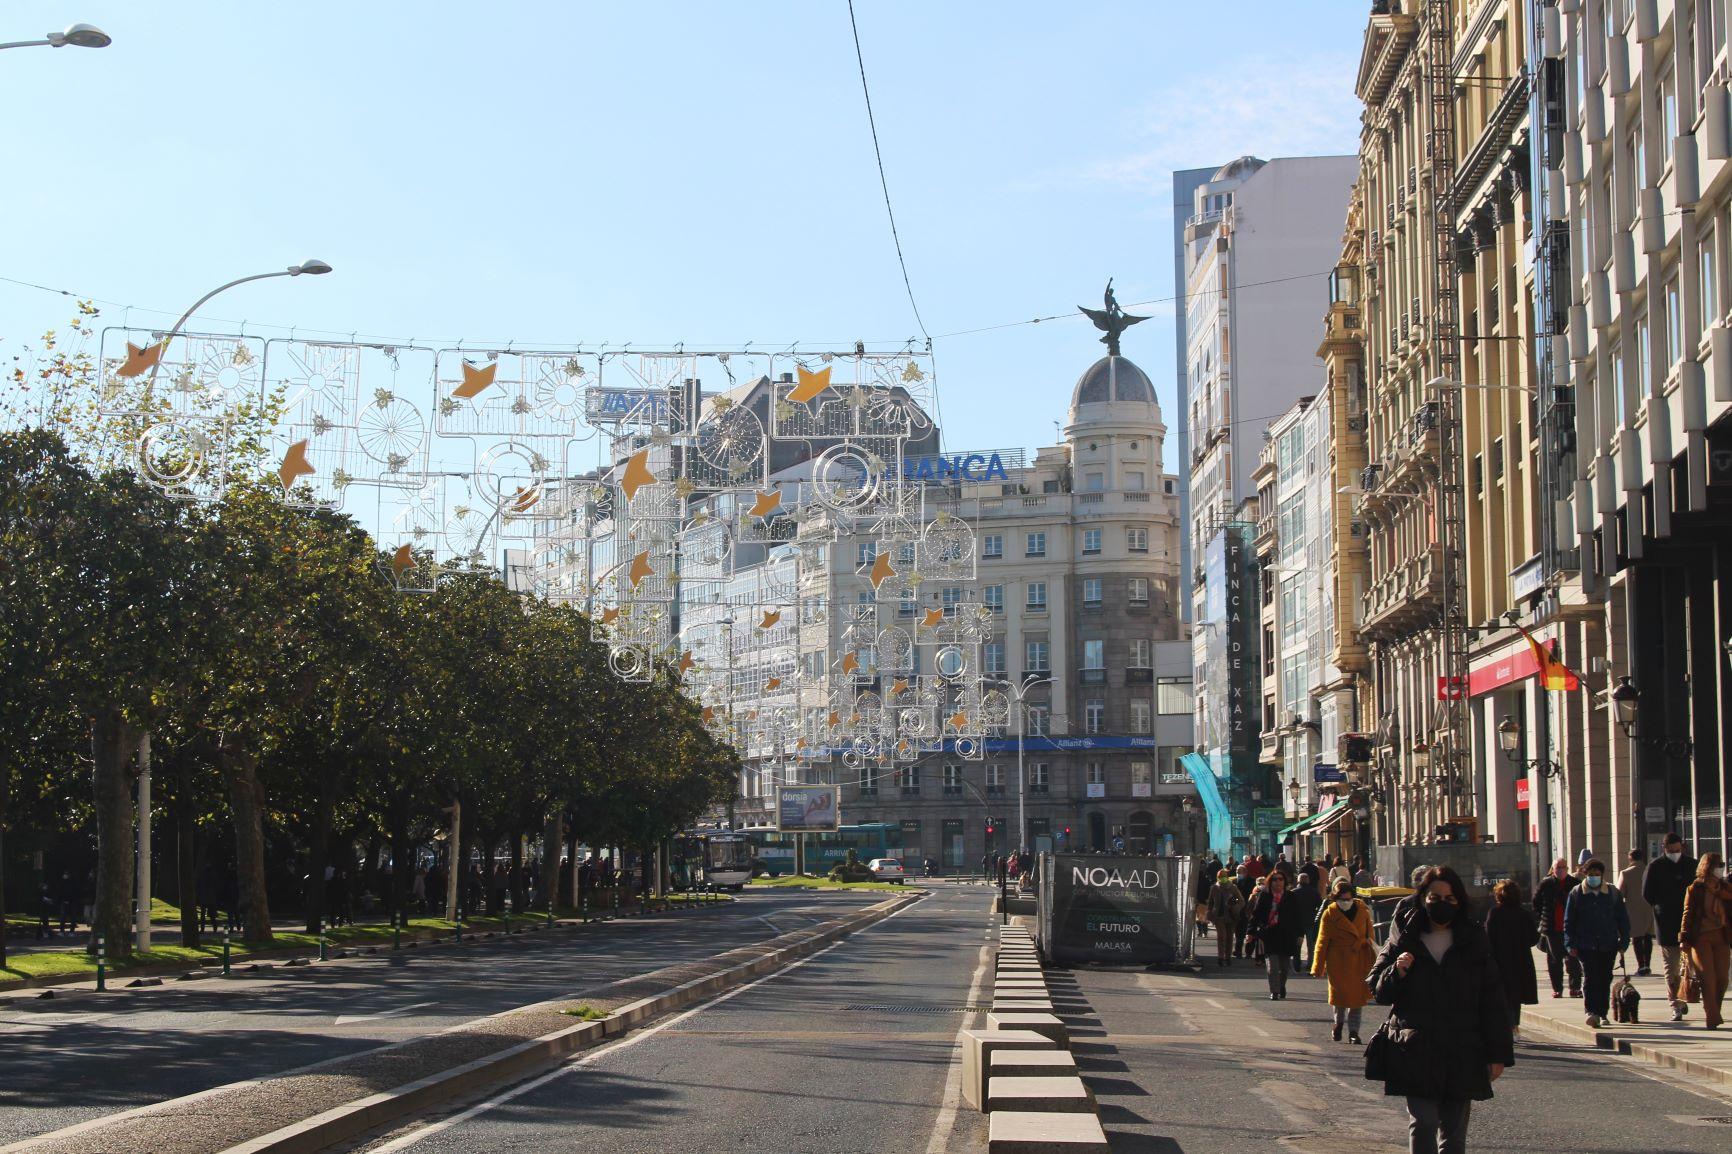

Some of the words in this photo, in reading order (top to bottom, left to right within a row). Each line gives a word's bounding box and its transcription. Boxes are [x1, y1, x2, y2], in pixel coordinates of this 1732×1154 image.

[885, 453, 1008, 481] BANCA
[1231, 546, 1240, 623] FINCA
[1232, 642, 1241, 670] DE
[1233, 688, 1243, 732] XAZ
[1057, 738, 1082, 747] Allianz
[782, 791, 809, 803] dorsia
[1099, 923, 1141, 933] FUTURO
[1094, 942, 1132, 950] MALASA
